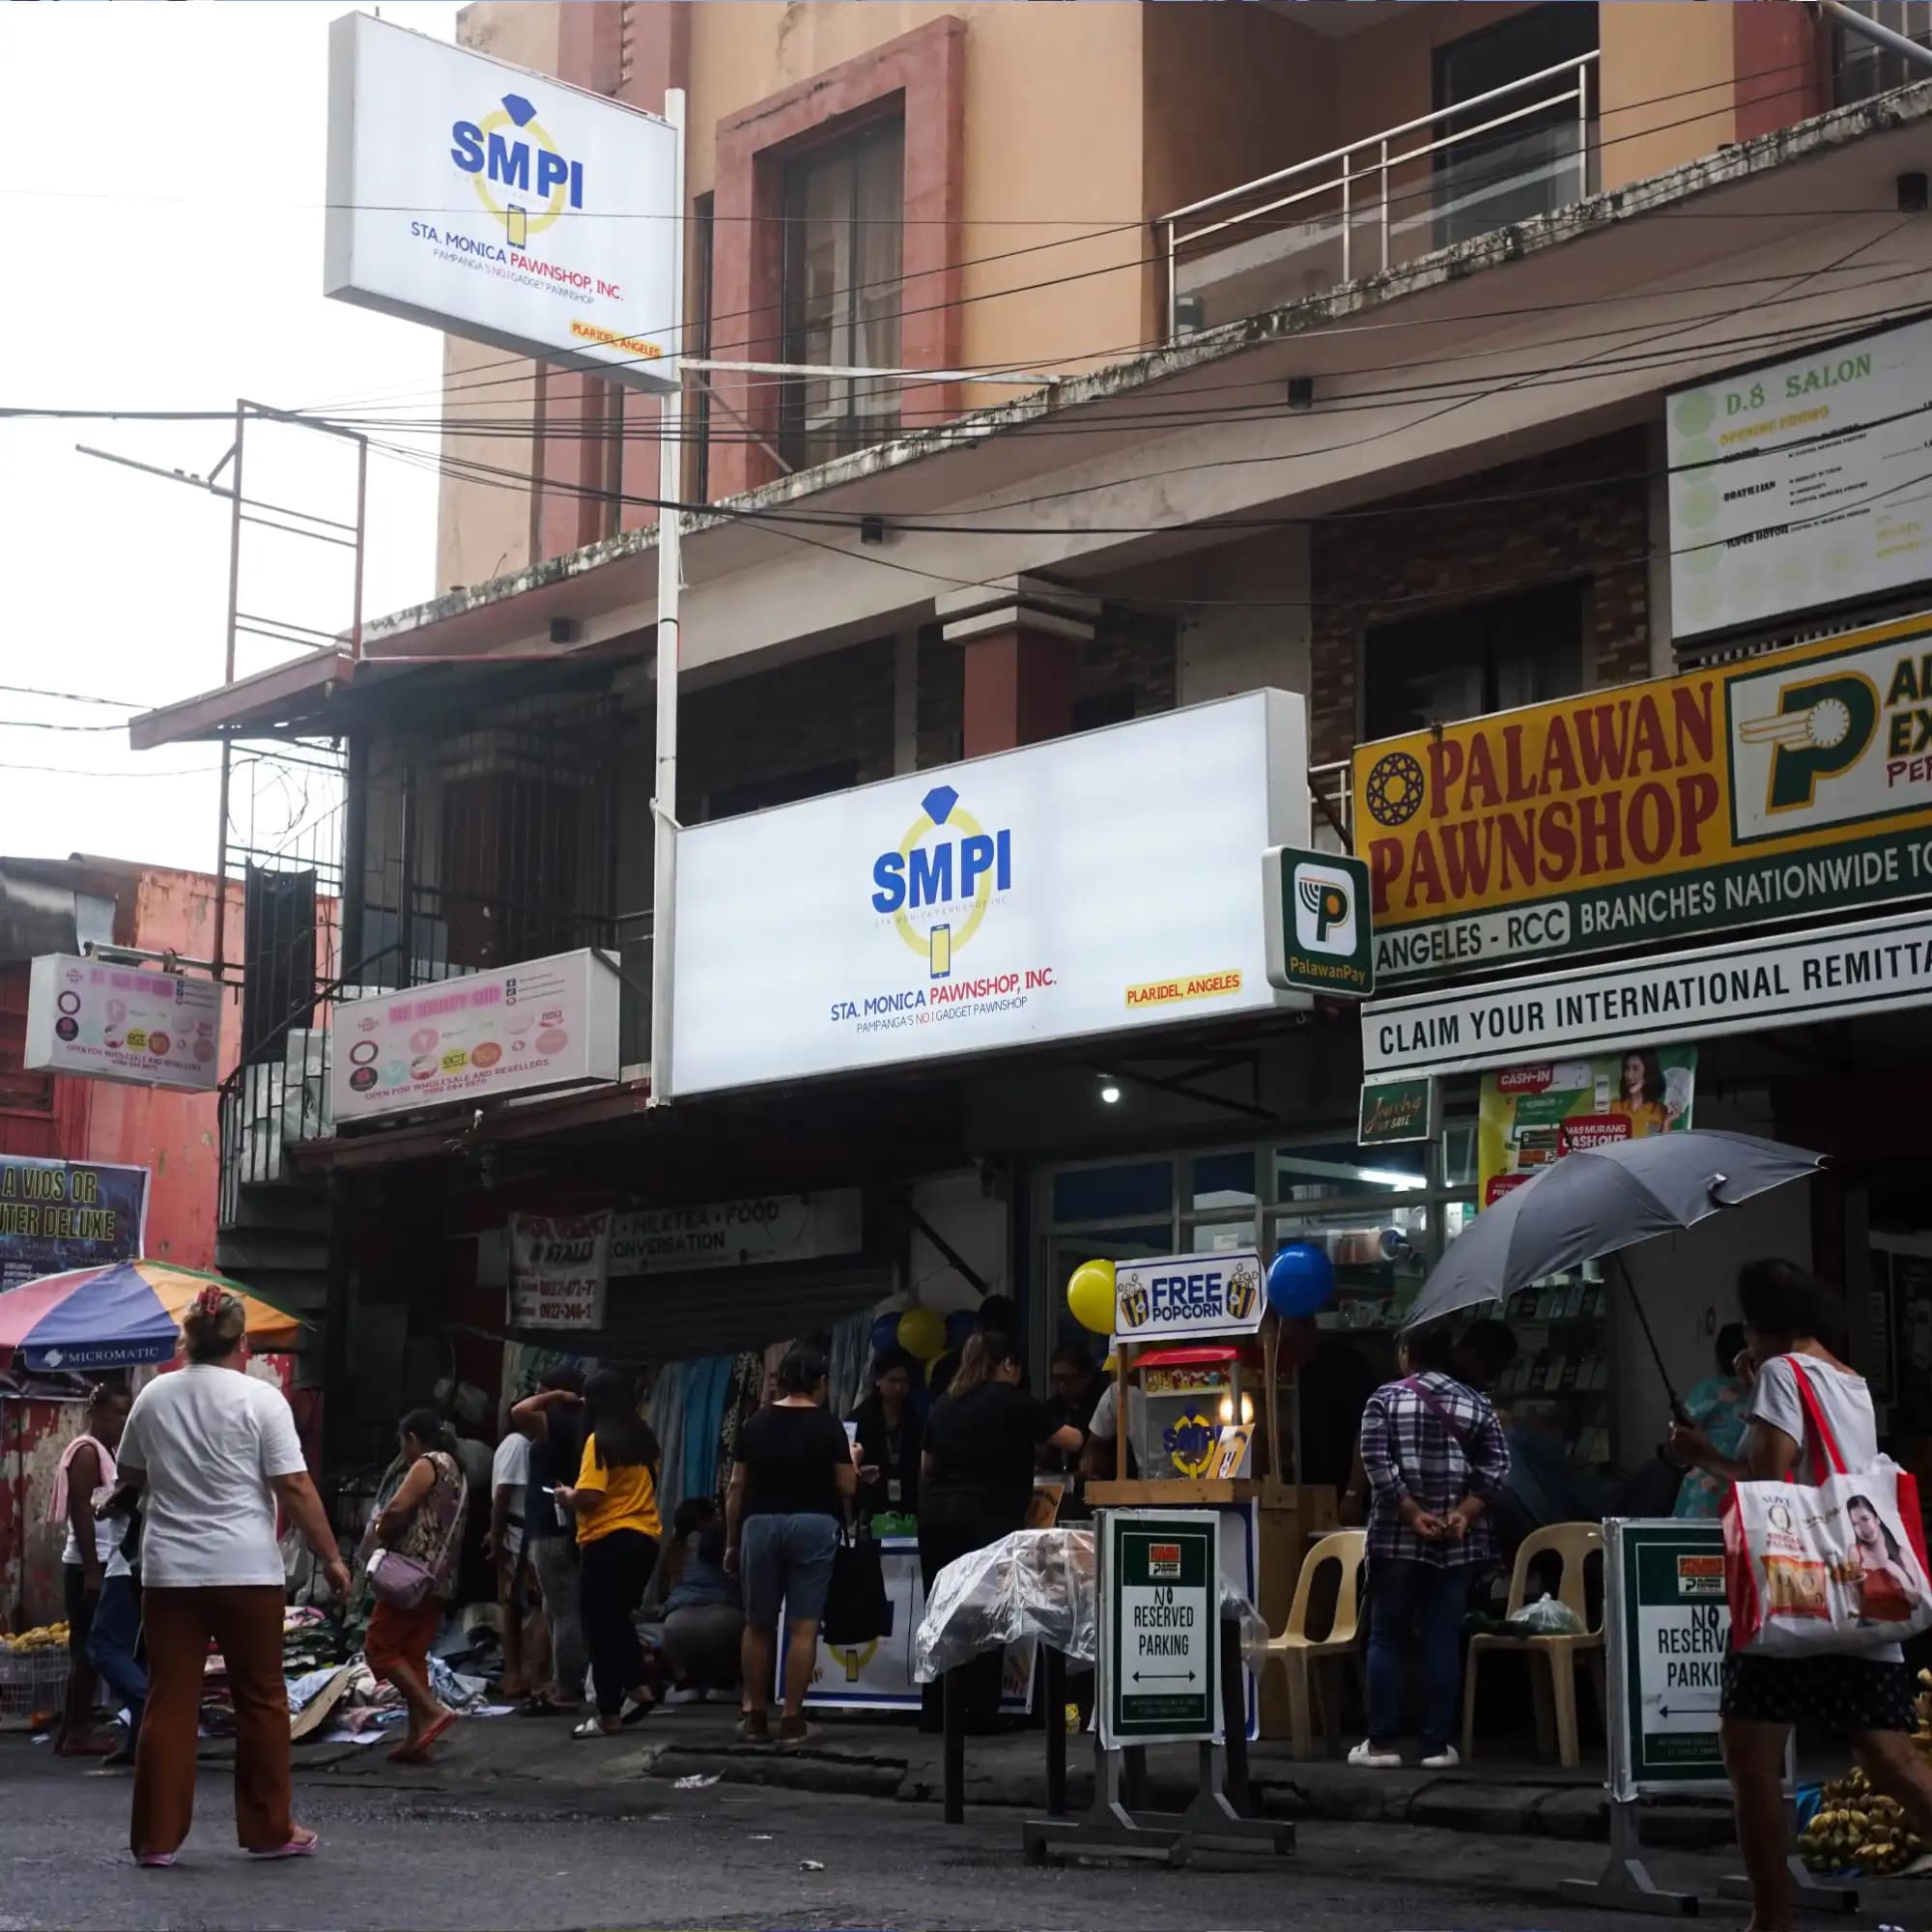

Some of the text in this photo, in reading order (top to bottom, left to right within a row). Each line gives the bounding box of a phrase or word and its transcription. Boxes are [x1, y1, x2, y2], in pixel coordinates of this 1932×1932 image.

[450, 120, 583, 210] SMPI
[412, 221, 624, 301] STA. MONICA PAWNSHOP, INC.
[1785, 354, 1871, 399] SALON
[1428, 681, 1715, 818] PALAWAN
[1369, 773, 1720, 914] PAWNSHOP
[871, 828, 1011, 914] SMPI
[1376, 923, 1482, 972] ANGELES
[1507, 905, 1566, 951] RCC
[1580, 880, 1717, 935] BRANCHES
[1724, 847, 1899, 910] NATIONWIDE
[1290, 954, 1366, 985] PalawanPay
[831, 968, 1058, 1022] STA. MONICA PAWNSHOP, INC.
[1127, 974, 1240, 1005] PLARIDEL, ANGELES
[857, 1015, 914, 1034] PAMPANGA'S
[936, 1006, 972, 1021] GADGET
[974, 996, 1029, 1015] PAWNSHOP
[1378, 1012, 1461, 1056] CLAIM
[1469, 1001, 1546, 1040] YOUR
[1556, 964, 1789, 1028] INTERNATIONAL
[1500, 1070, 1550, 1086] CASH-IN
[1584, 1123, 1627, 1135] MURANG
[3, 1167, 97, 1204] A VIOS OR
[43, 1207, 116, 1241] DELUXE
[1151, 1272, 1222, 1306] FREE
[1152, 1302, 1223, 1322] POPCORN
[69, 1348, 159, 1364] MICROMATIC
[1154, 1587, 1174, 1605] NO
[1134, 1605, 1194, 1628] RESERVED
[1691, 1605, 1719, 1630] NO
[1139, 1634, 1189, 1656] PARKING
[1658, 1628, 1725, 1654] RESERV
[1667, 1662, 1723, 1688] PARKI
